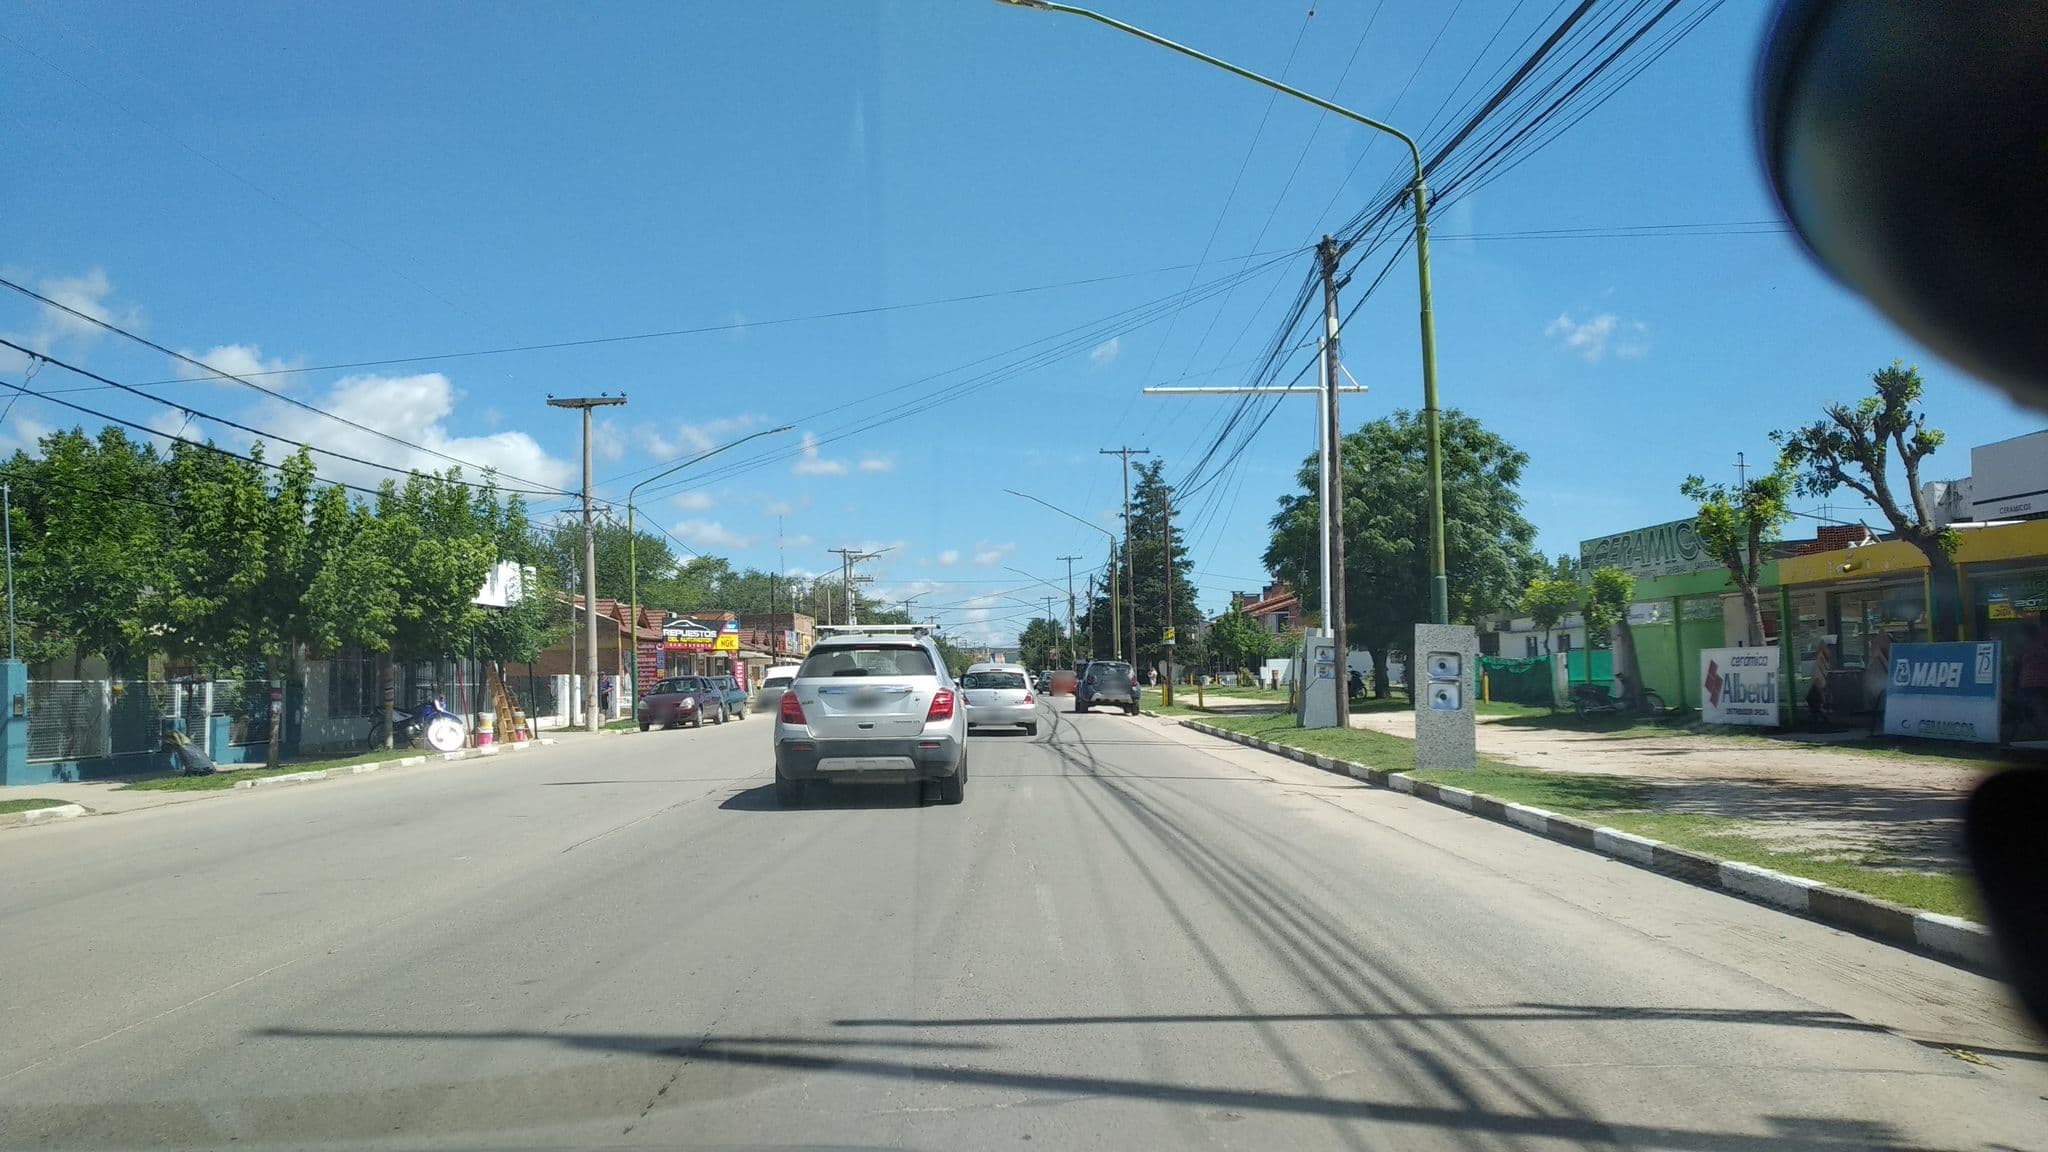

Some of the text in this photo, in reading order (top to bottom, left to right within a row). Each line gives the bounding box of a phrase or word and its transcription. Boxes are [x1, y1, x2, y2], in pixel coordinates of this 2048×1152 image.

[1999, 503, 2032, 514] CERAMICOS
[662, 628, 717, 638] REPUESTOS
[721, 640, 734, 648] NGK
[1910, 661, 1964, 688] MAPEI
[1723, 672, 1775, 703] Alberdi
